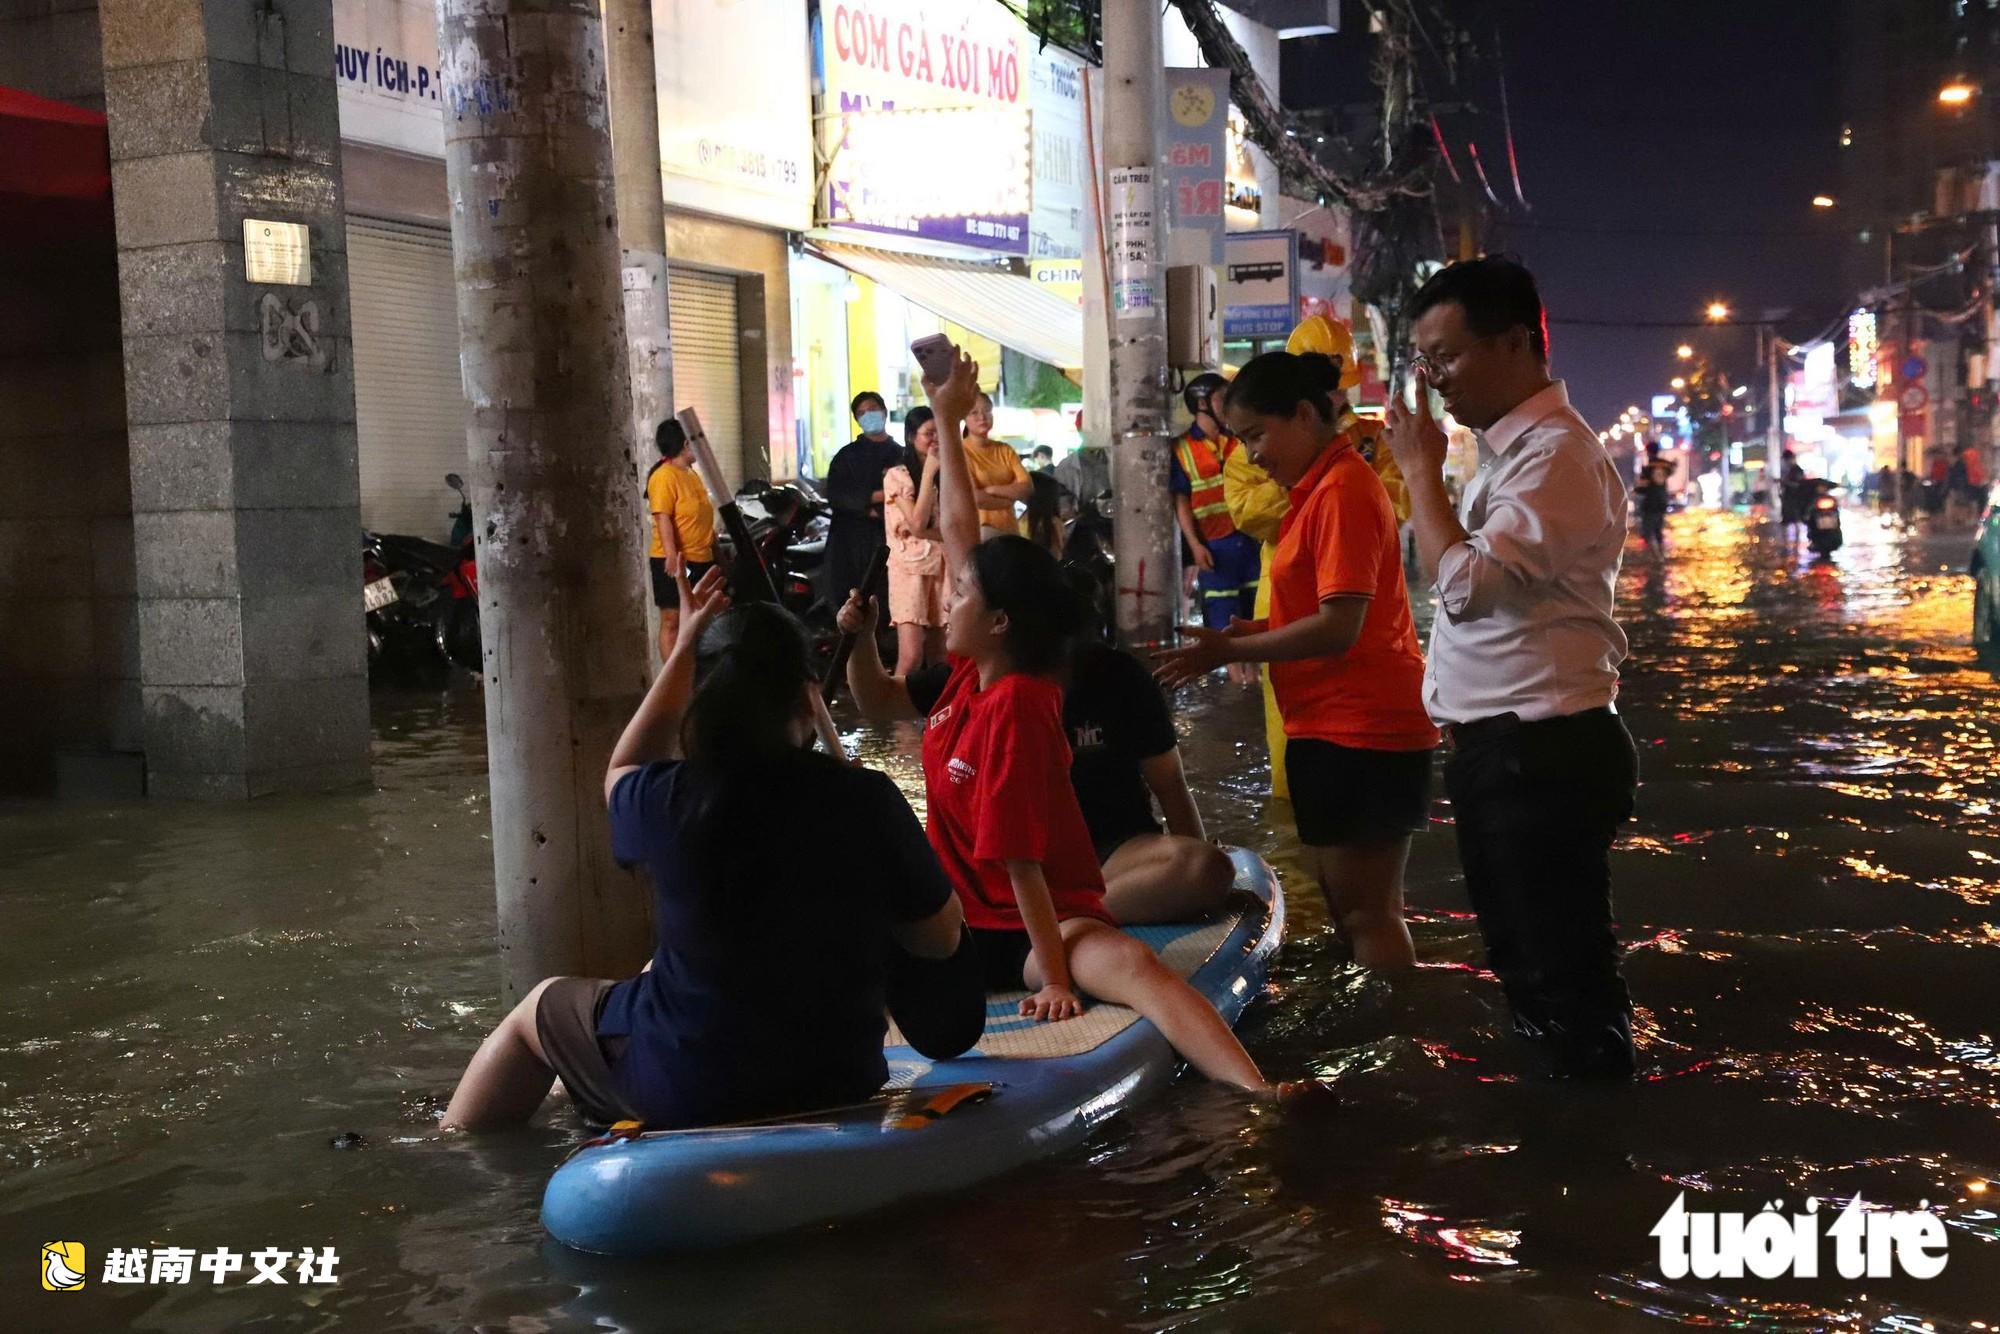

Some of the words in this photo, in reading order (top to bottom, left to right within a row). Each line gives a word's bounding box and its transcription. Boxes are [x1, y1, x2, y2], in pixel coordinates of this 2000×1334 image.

[898, 11, 933, 83] GÀ
[941, 16, 980, 95] XỐI
[1231, 322, 1253, 333] BUS
[1256, 321, 1285, 332] STOP
